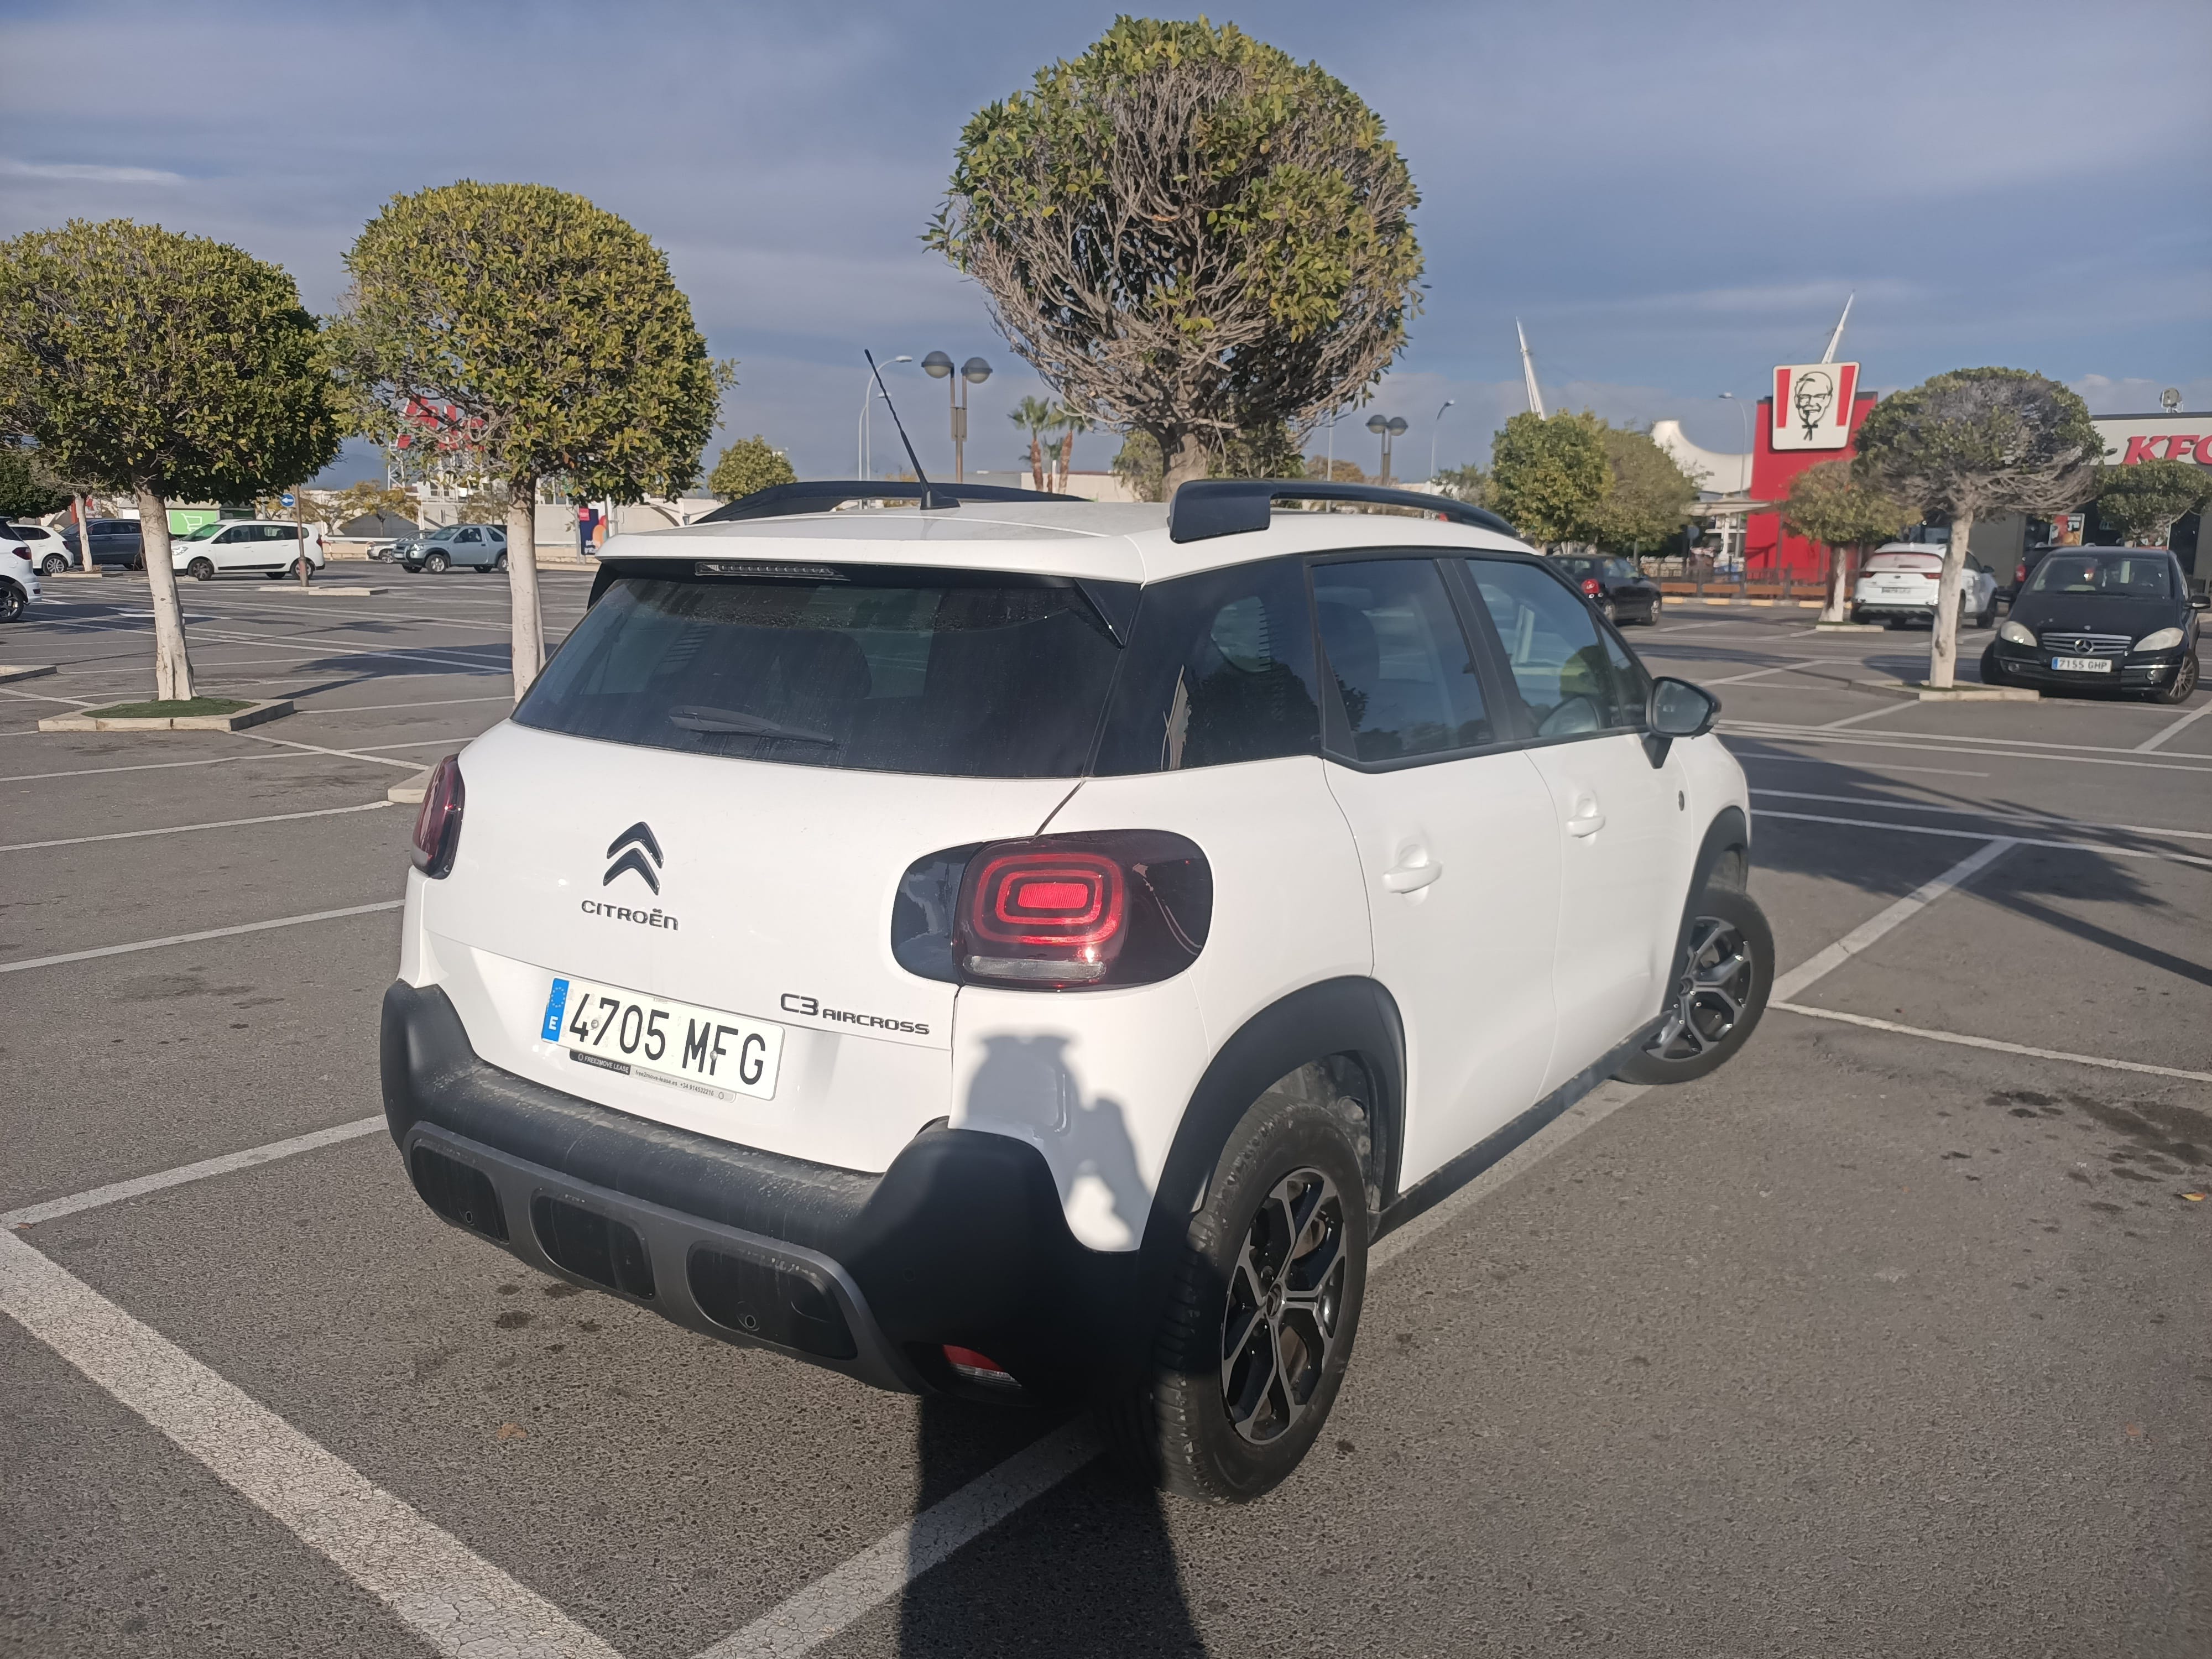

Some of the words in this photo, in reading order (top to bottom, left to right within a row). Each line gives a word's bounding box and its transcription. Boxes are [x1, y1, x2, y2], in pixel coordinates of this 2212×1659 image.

[2059, 659, 2084, 669] 7155
[2088, 661, 2107, 670] GHP
[581, 900, 679, 931] CITROËN
[780, 993, 818, 1016] C3
[822, 1008, 930, 1035] AIRCROSS
[549, 1016, 559, 1030] E
[569, 993, 670, 1061] 4705
[682, 1018, 766, 1085] MFG
[584, 1056, 613, 1068] FREE2MOVE
[613, 1063, 629, 1073] LEASE
